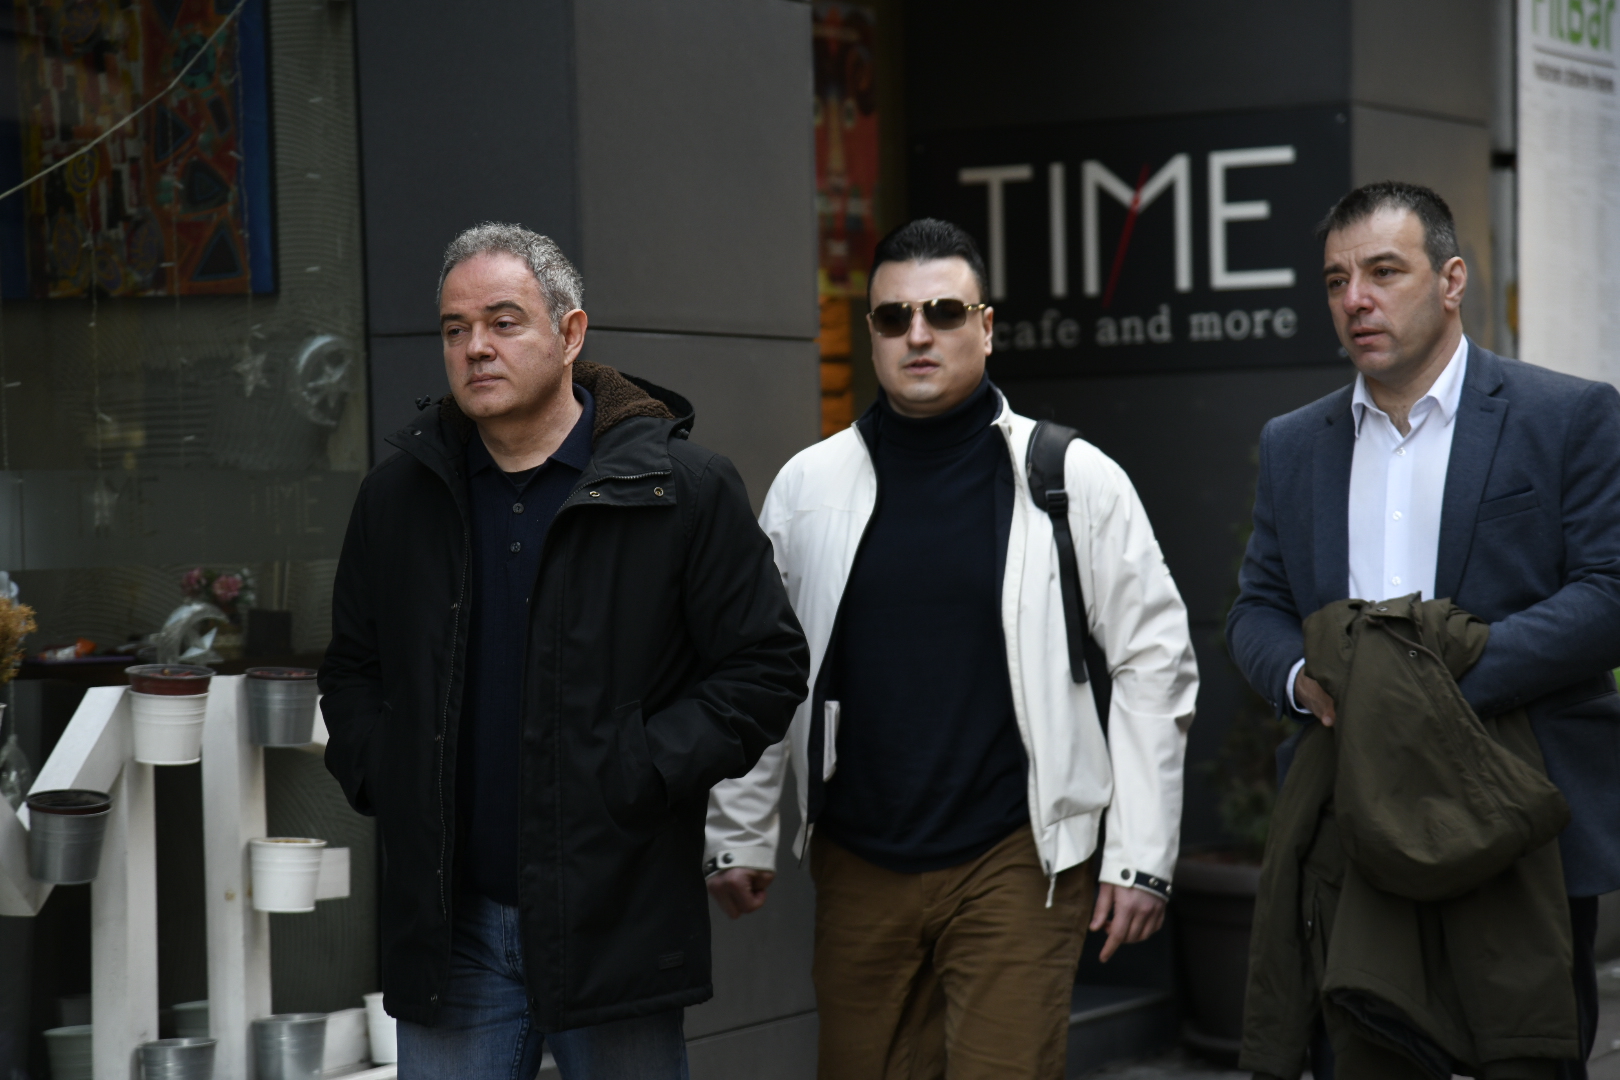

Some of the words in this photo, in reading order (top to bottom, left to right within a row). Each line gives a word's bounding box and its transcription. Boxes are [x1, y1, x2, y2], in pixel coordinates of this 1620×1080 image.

[958, 145, 1296, 300] TIME
[993, 308, 1082, 350] cafe
[1095, 303, 1173, 346] and
[1189, 307, 1298, 342] more
